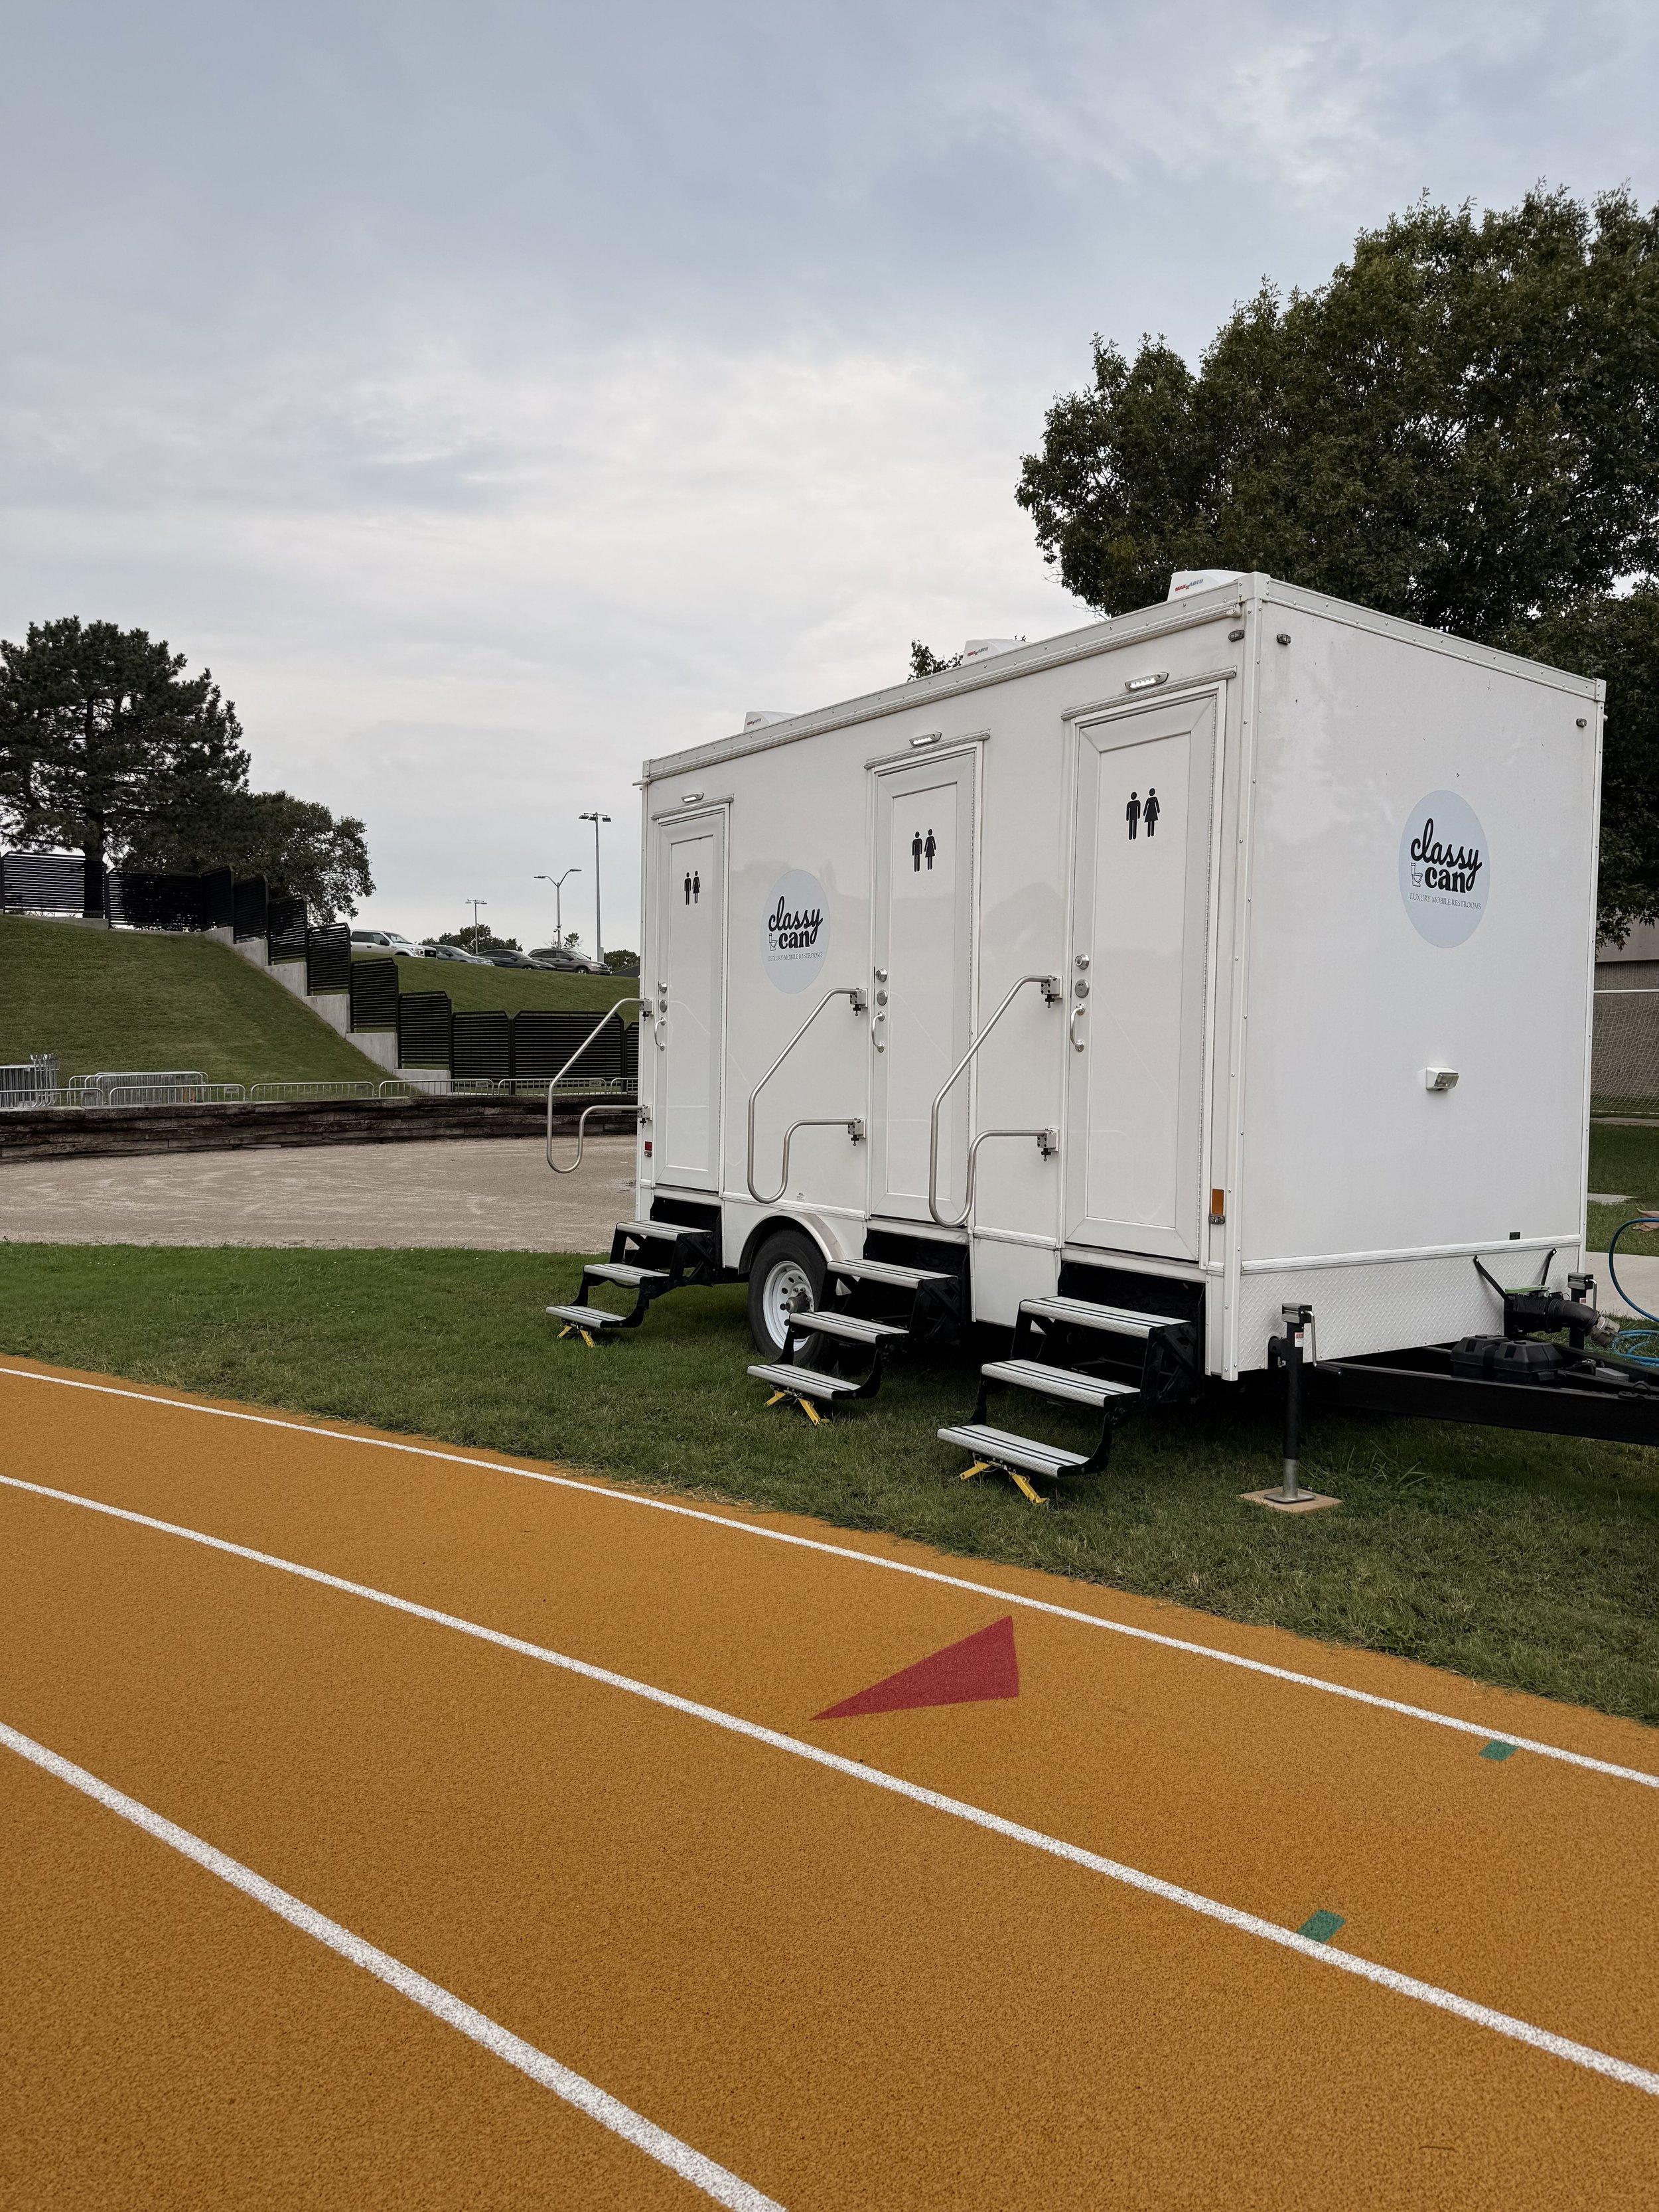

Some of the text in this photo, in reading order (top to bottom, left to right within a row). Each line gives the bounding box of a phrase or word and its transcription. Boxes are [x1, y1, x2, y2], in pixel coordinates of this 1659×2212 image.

[1410, 818, 1482, 891] classy
[1425, 867, 1466, 893] can
[1409, 893, 1482, 910] LUXURY MOBILE RESTROOMS
[768, 896, 824, 944] classy
[778, 930, 810, 949] can
[798, 951, 823, 960] RESTROOMS
